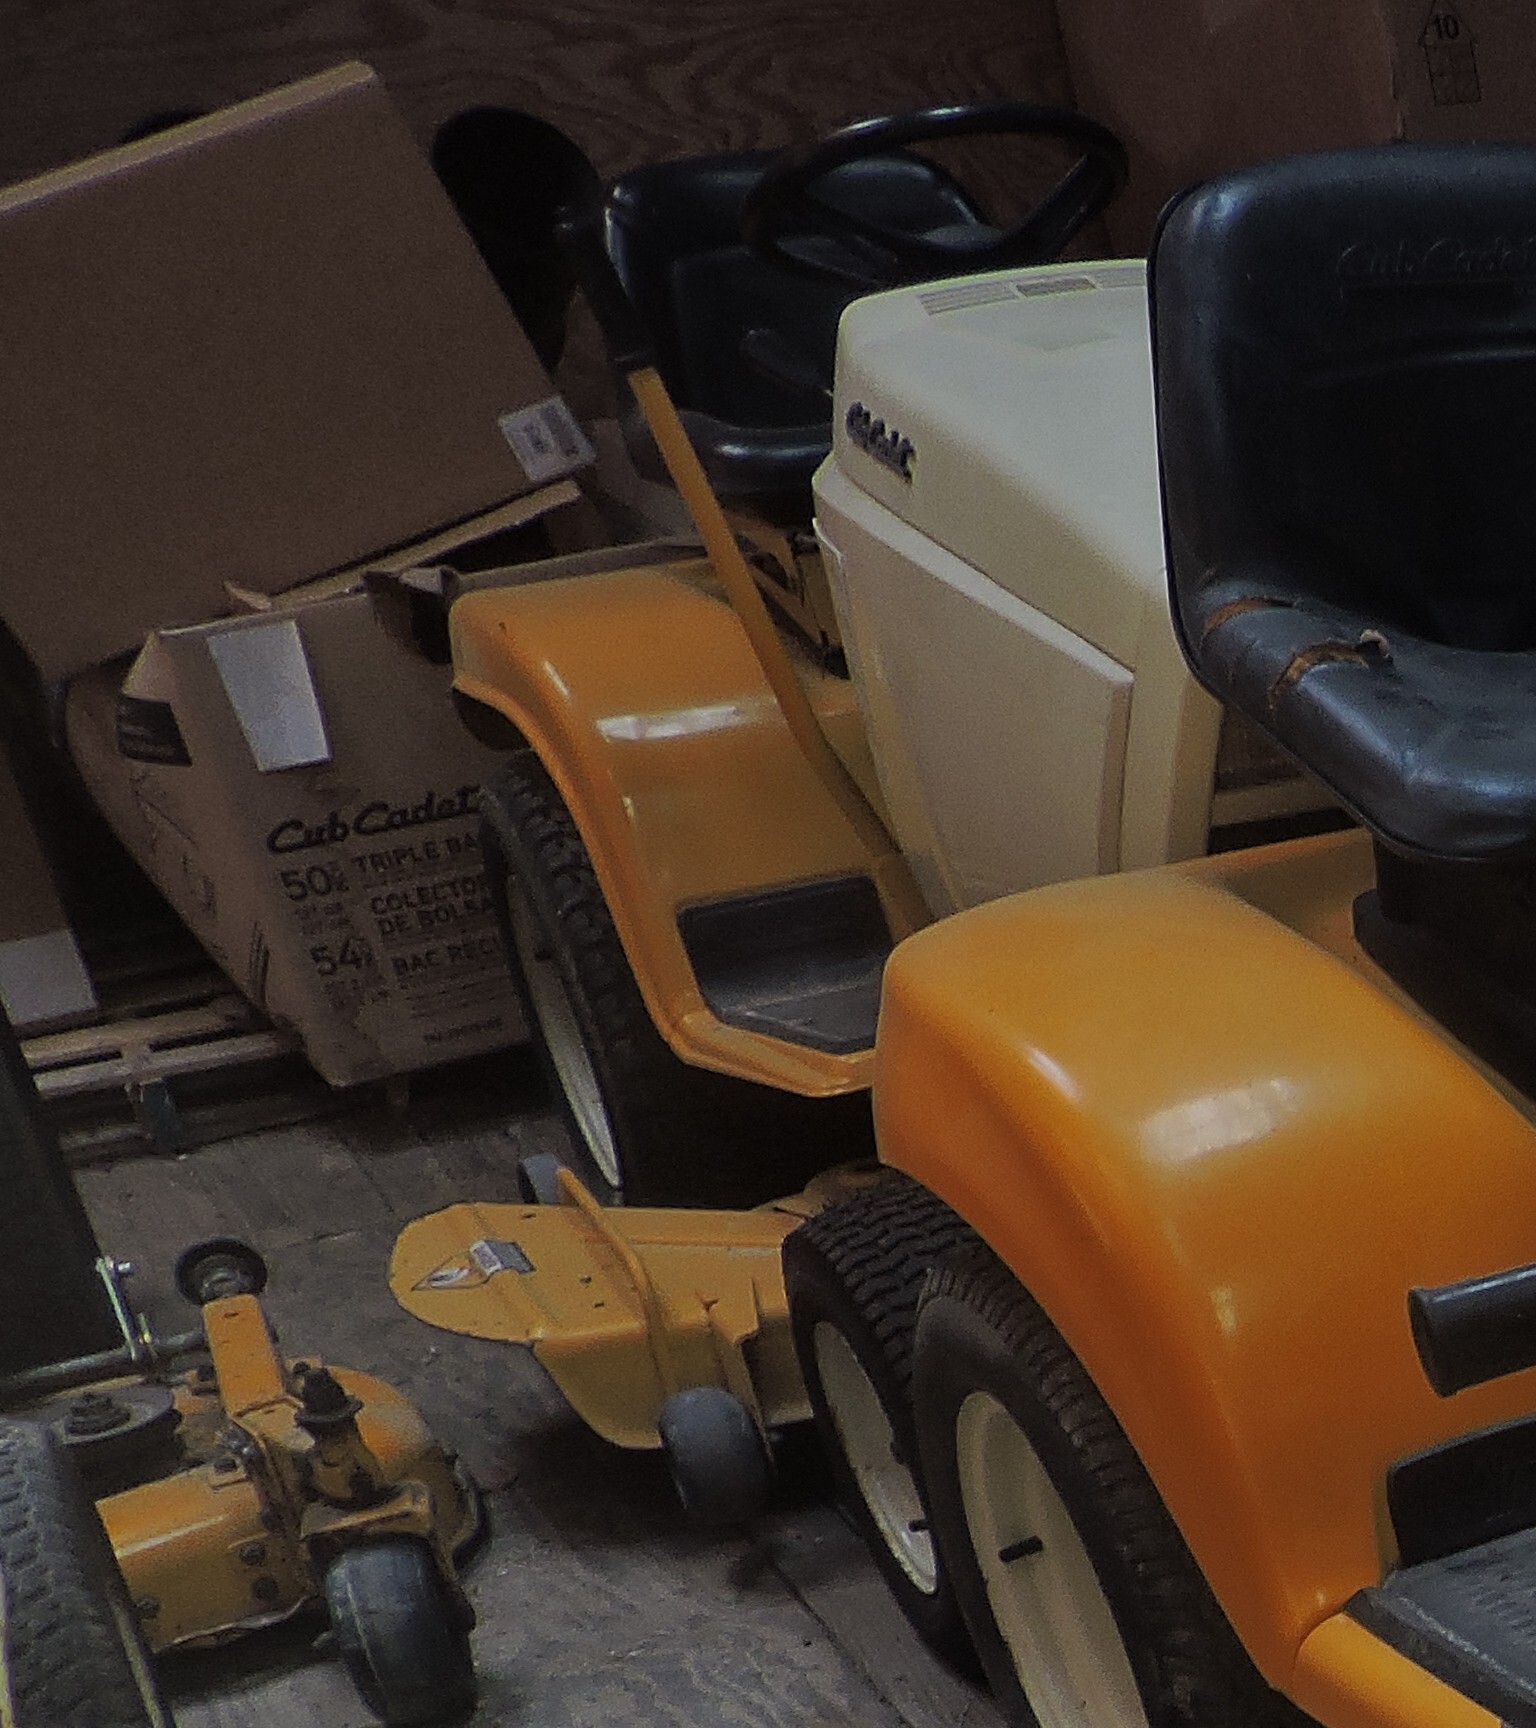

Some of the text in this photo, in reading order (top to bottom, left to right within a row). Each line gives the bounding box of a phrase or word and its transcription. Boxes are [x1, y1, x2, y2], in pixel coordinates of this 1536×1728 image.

[1434, 14, 1459, 40] 10
[266, 784, 482, 853] Cub Cadet
[353, 832, 480, 873] TRIPLE BA
[280, 865, 332, 901] 50
[378, 914, 410, 936] DE
[310, 938, 361, 975] 54
